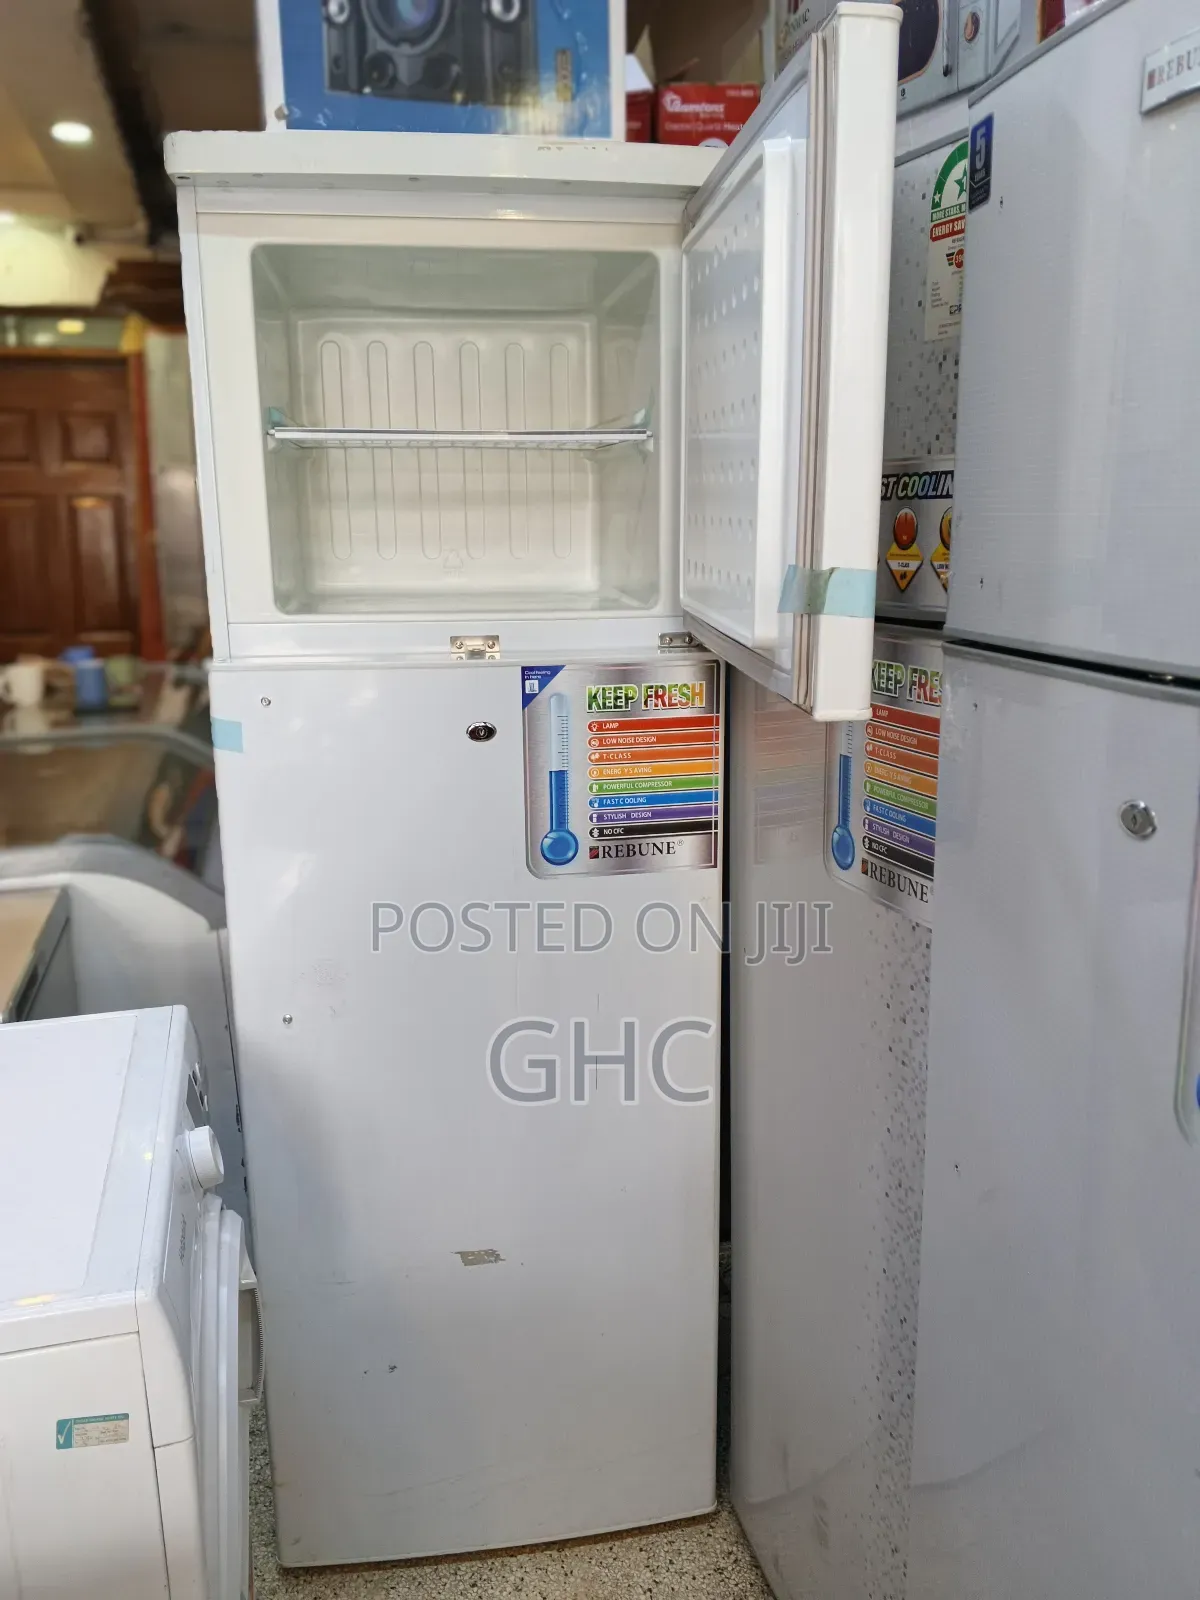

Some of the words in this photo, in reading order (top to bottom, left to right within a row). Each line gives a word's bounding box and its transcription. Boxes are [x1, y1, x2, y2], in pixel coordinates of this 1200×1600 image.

[975, 125, 986, 170] 5
[932, 222, 953, 237] ENERGY
[586, 684, 638, 713] KEEP
[642, 681, 706, 710] FRESH
[876, 708, 889, 718] LAMP
[602, 737, 617, 745] LOW
[617, 736, 635, 744] NOISE
[875, 728, 886, 737] LOW
[886, 729, 900, 741] NOISE
[900, 735, 918, 745] DESIGN
[602, 752, 632, 760] T-CLASS
[873, 786, 897, 800] POWERFUL
[896, 795, 929, 810] COMPRESSOR
[872, 823, 890, 836] STYLISH
[892, 831, 910, 844] DESIGN
[871, 842, 880, 850] NO
